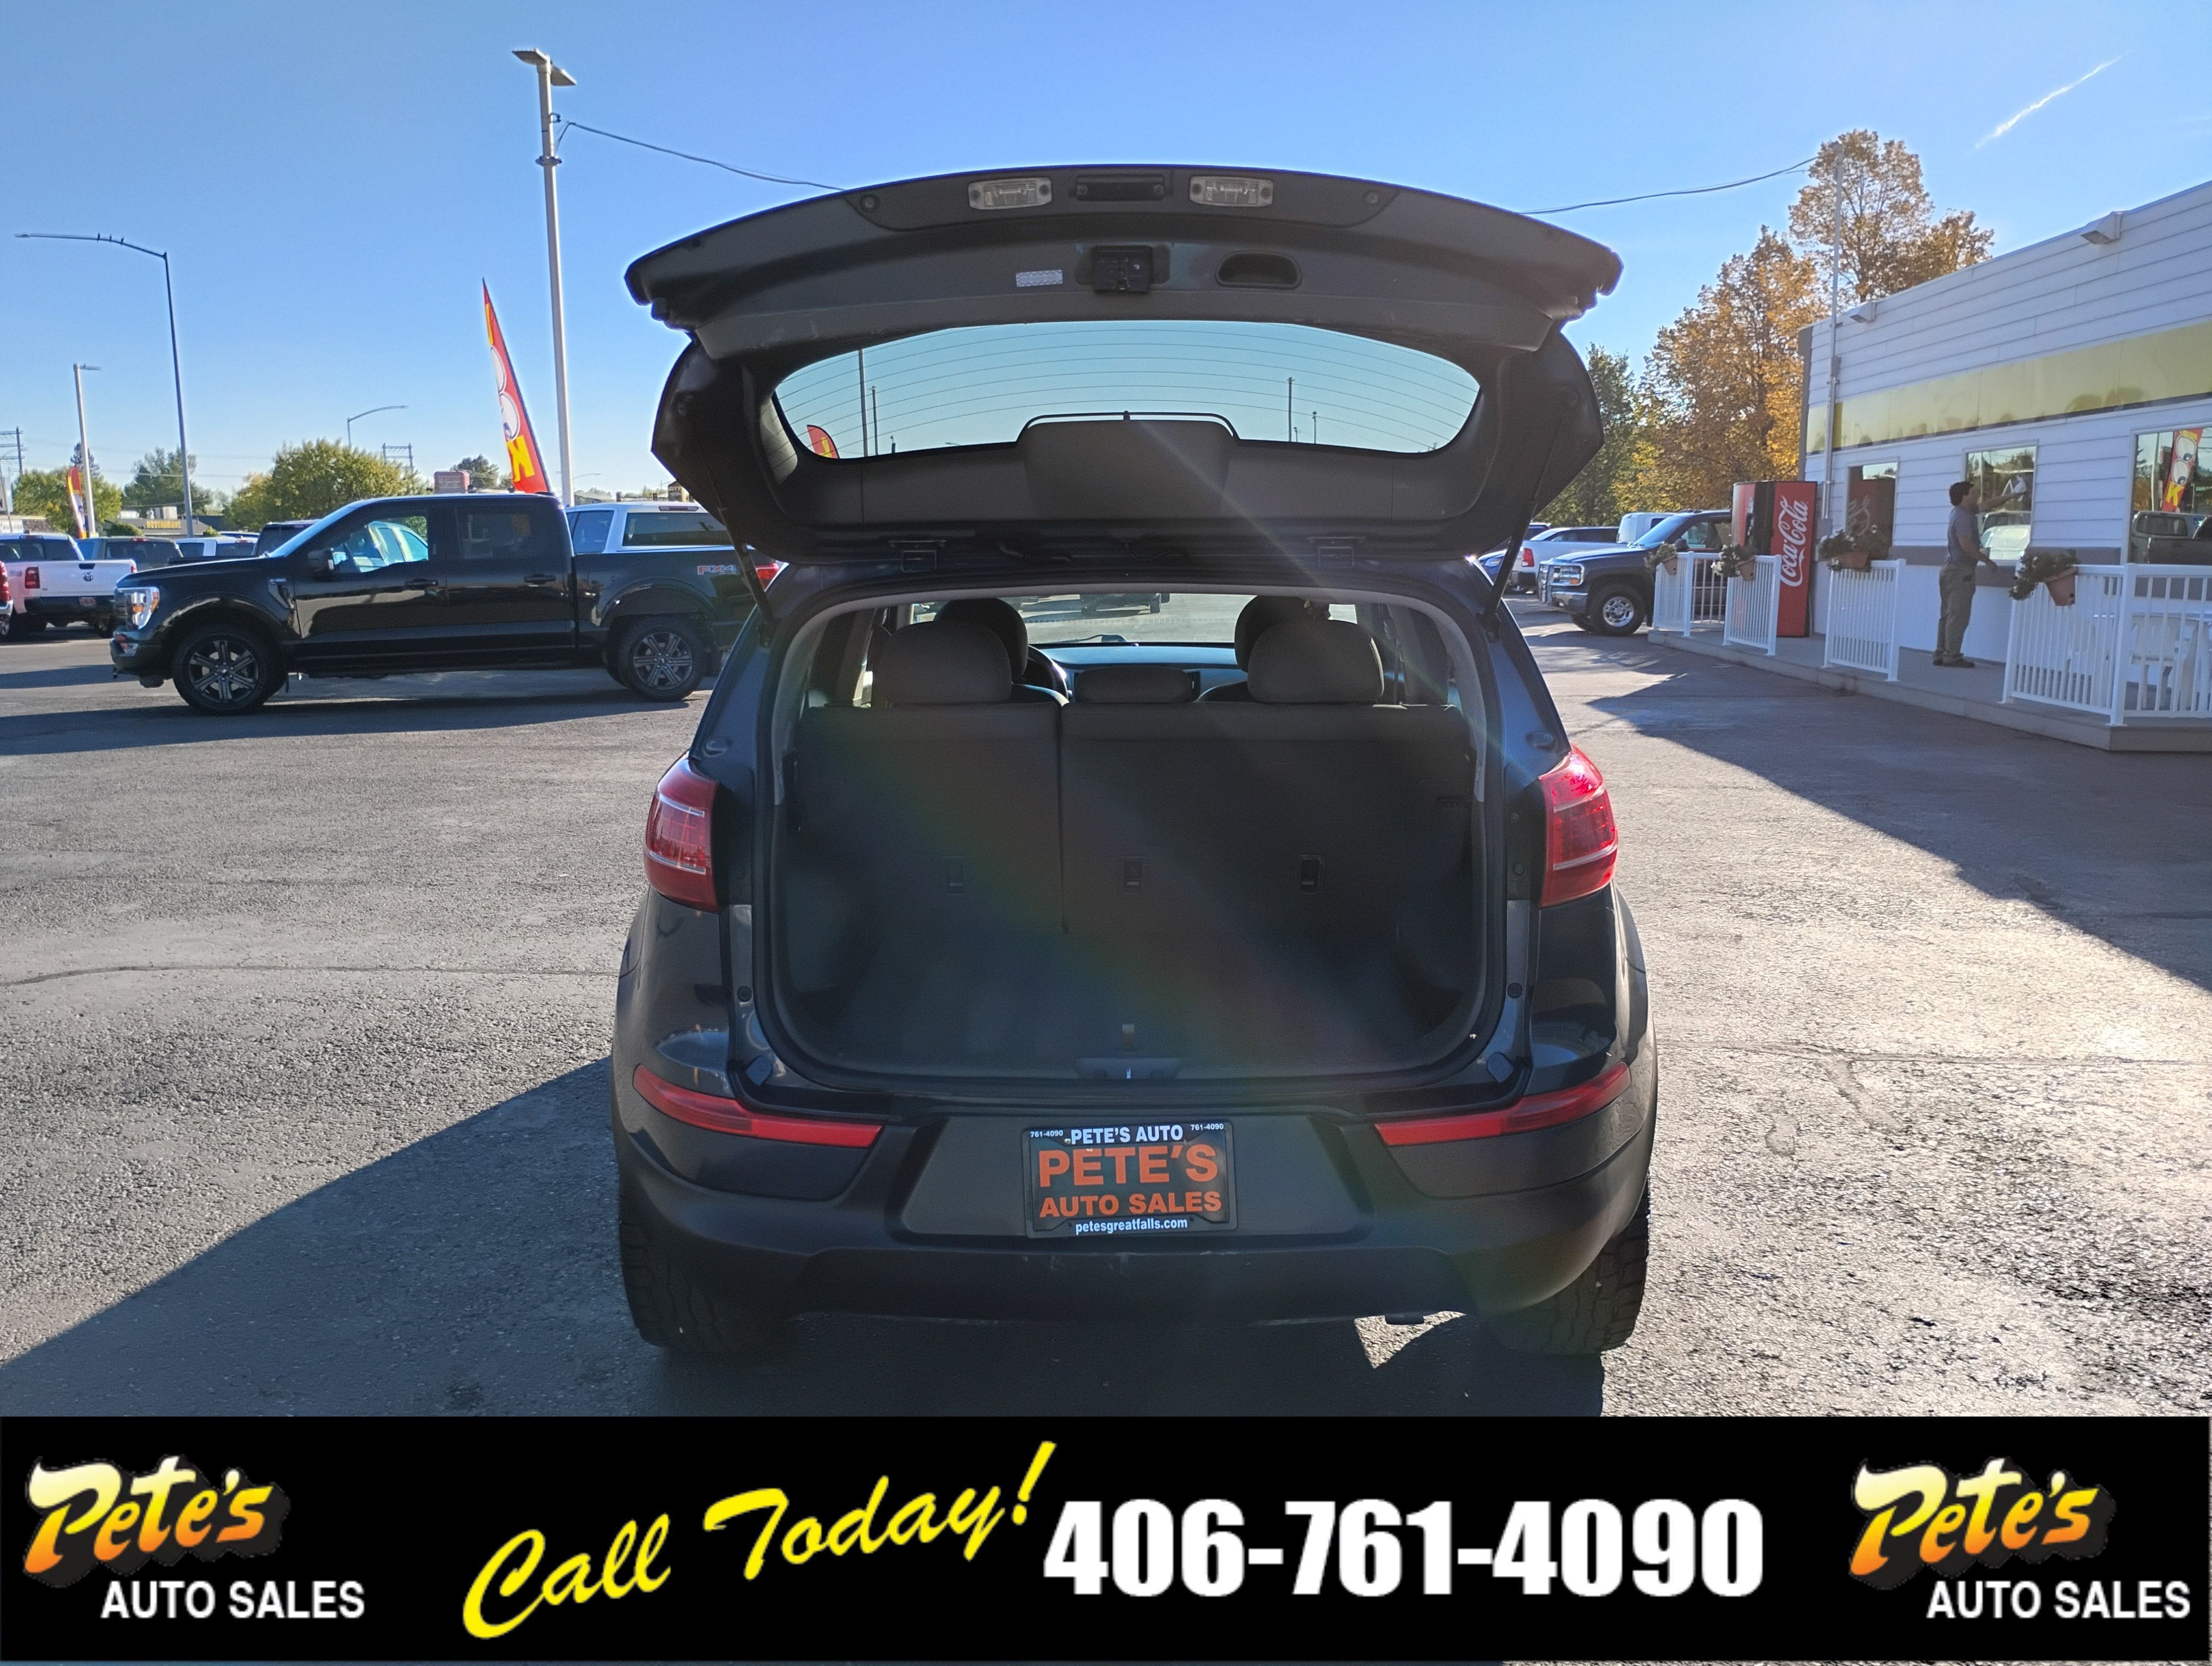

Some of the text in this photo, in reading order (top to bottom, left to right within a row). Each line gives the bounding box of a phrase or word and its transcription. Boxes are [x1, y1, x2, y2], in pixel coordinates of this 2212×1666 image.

[697, 565, 737, 575] FX4
[1030, 1130, 1064, 1138] 761-4090
[1071, 1124, 1184, 1145] PETE'S AUTO
[1190, 1123, 1224, 1131] 761-4090
[1039, 1144, 1218, 1187] PETE'S
[1040, 1191, 1221, 1218] AUTO SALES
[1075, 1218, 1188, 1235] petesgreatfalls.com
